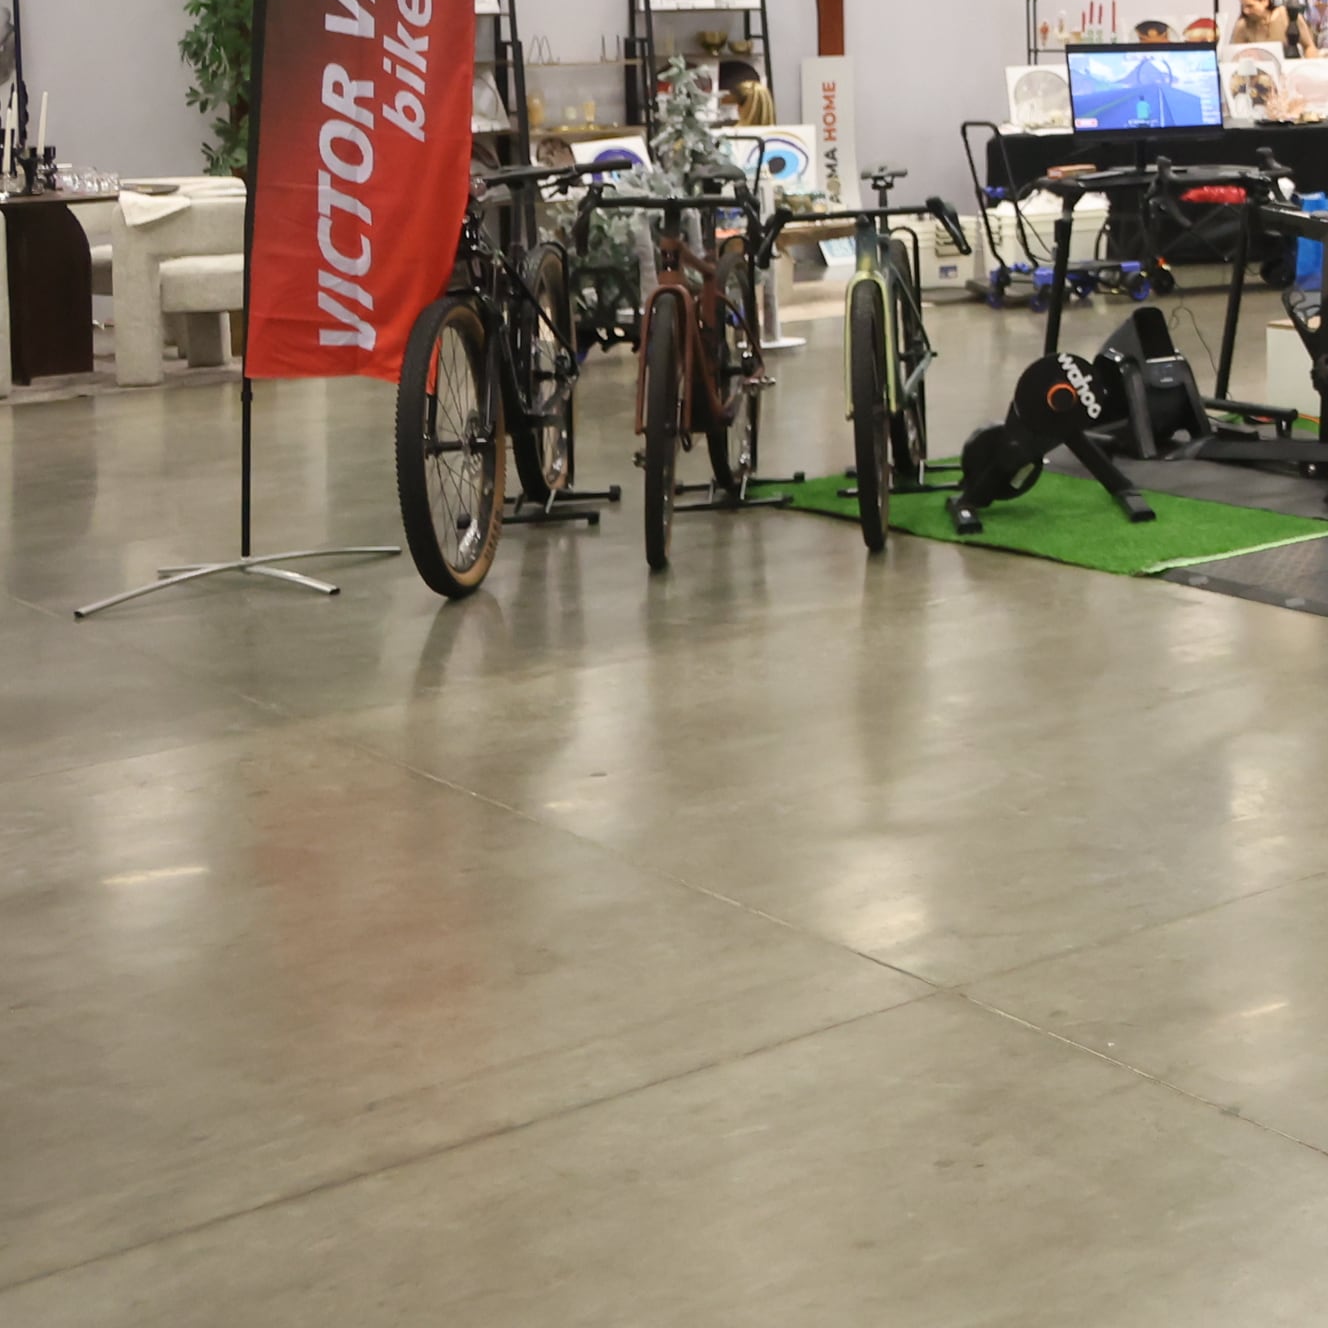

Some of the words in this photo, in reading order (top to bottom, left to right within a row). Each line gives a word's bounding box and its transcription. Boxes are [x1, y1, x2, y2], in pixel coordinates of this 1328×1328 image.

[822, 80, 837, 141] HOME
[318, 62, 375, 352] VICTOR
[1057, 353, 1101, 419] wahoo
